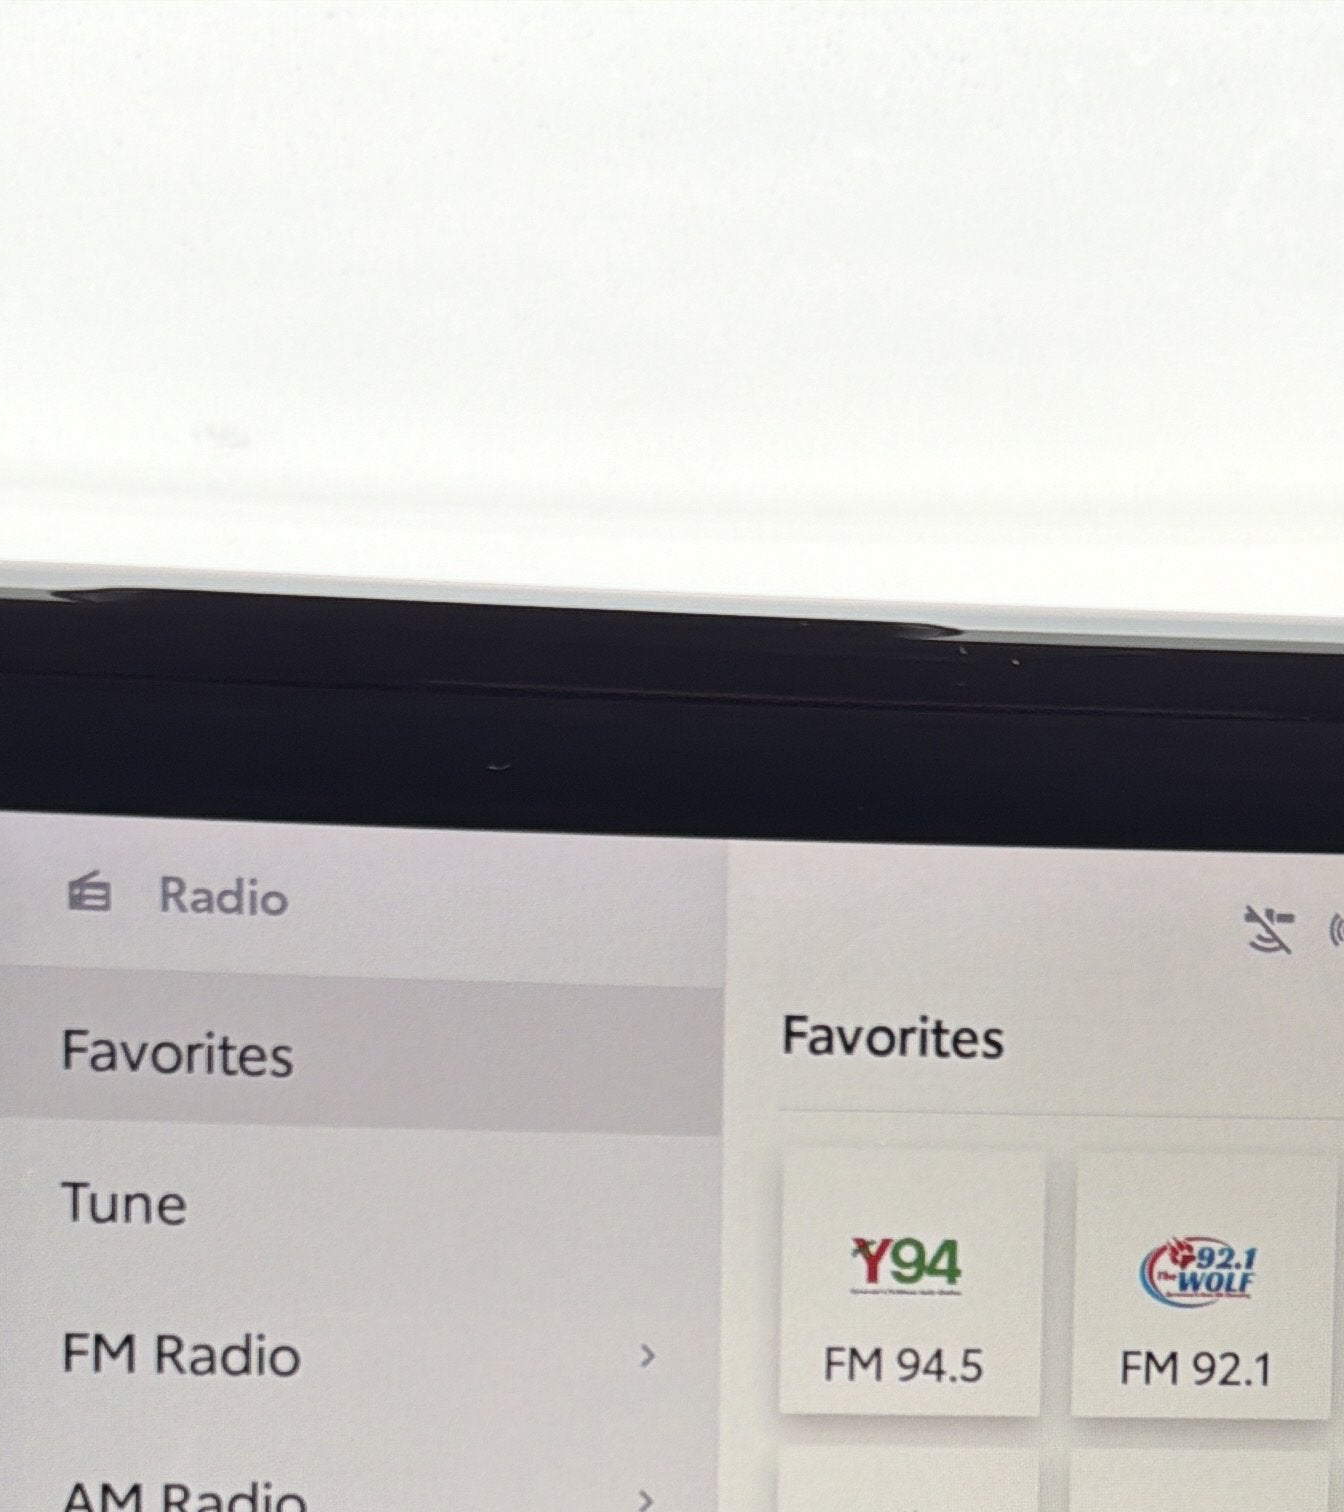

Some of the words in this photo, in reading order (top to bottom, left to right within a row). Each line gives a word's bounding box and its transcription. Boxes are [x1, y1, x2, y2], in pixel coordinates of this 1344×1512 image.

[159, 874, 290, 918] Radio
[63, 1028, 294, 1079] Favorites
[782, 1013, 1005, 1061] Favorites
[60, 1180, 187, 1227] Tune
[852, 1237, 962, 1284] Y94
[1196, 1246, 1257, 1269] 92.1
[1178, 1271, 1256, 1292] WOLF
[63, 1331, 136, 1374] FM
[155, 1332, 301, 1379] Radio
[825, 1345, 883, 1383] FM
[896, 1346, 984, 1384] 94.5
[1120, 1349, 1179, 1386] FM
[1191, 1350, 1270, 1388] 92.1
